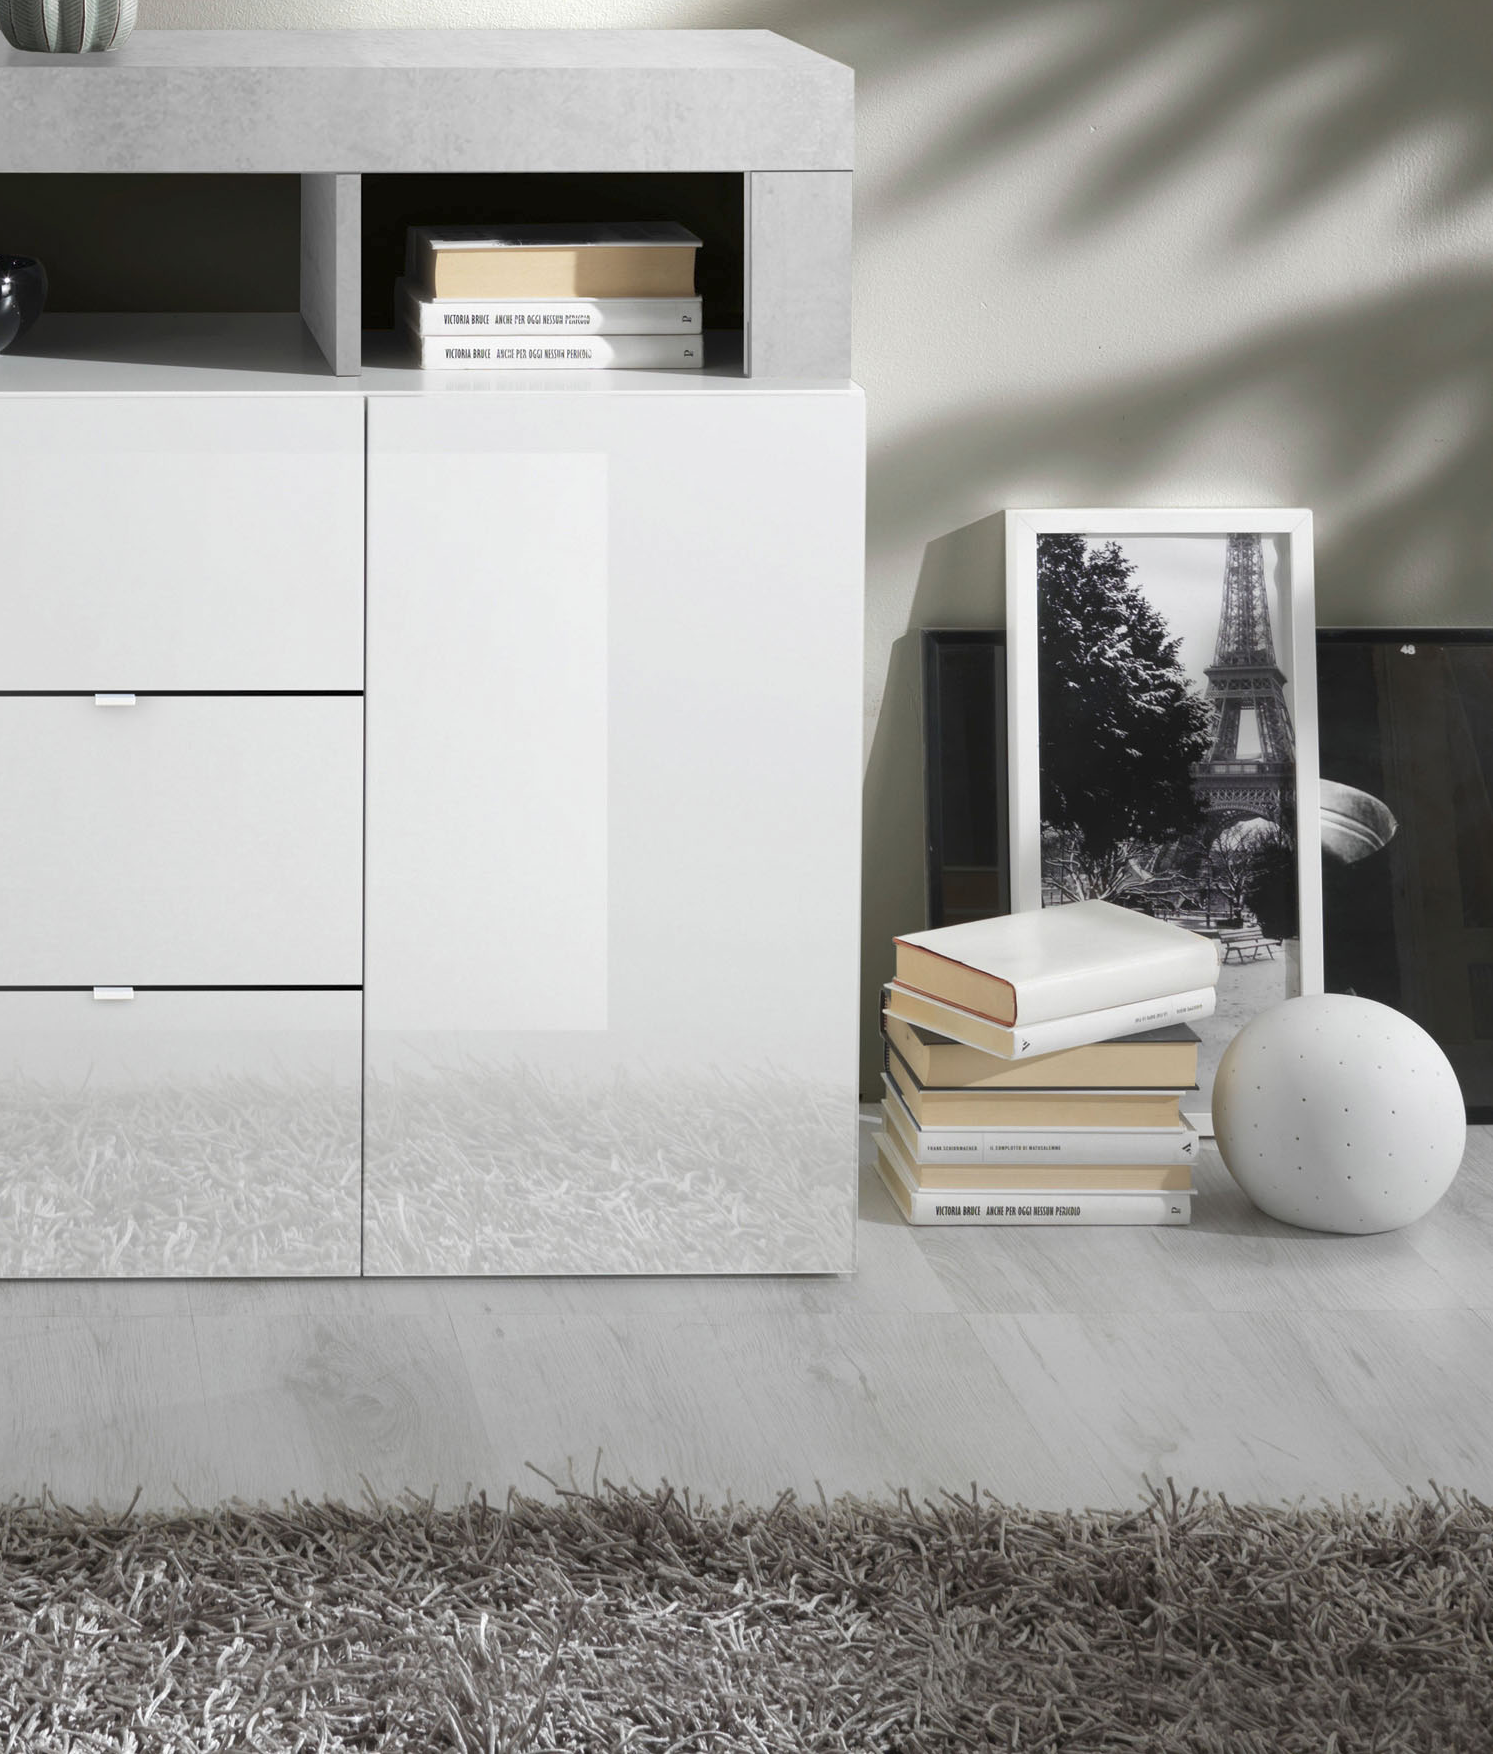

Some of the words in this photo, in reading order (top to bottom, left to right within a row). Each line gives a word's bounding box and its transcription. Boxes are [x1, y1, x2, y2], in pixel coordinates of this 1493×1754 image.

[444, 315, 470, 325] VICTORIA
[471, 315, 489, 325] BRUCE
[495, 315, 512, 325] ANCHE
[514, 315, 525, 325] PER
[527, 315, 541, 325] OGGI
[543, 315, 563, 325] NESSUN
[445, 349, 471, 359] VICTORIA
[473, 349, 491, 359] BRUCE
[496, 349, 514, 359] ANCHE
[516, 349, 527, 359] PER
[528, 349, 543, 359] OGGI
[935, 1206, 961, 1216] VICTORIA
[963, 1206, 981, 1216] BRUCE
[986, 1206, 1004, 1216] ANCHE
[1005, 1206, 1016, 1216] PER
[1018, 1206, 1032, 1216] OGGI
[1033, 1206, 1054, 1216] NESSUN
[1055, 1206, 1081, 1216] PERICOLO
